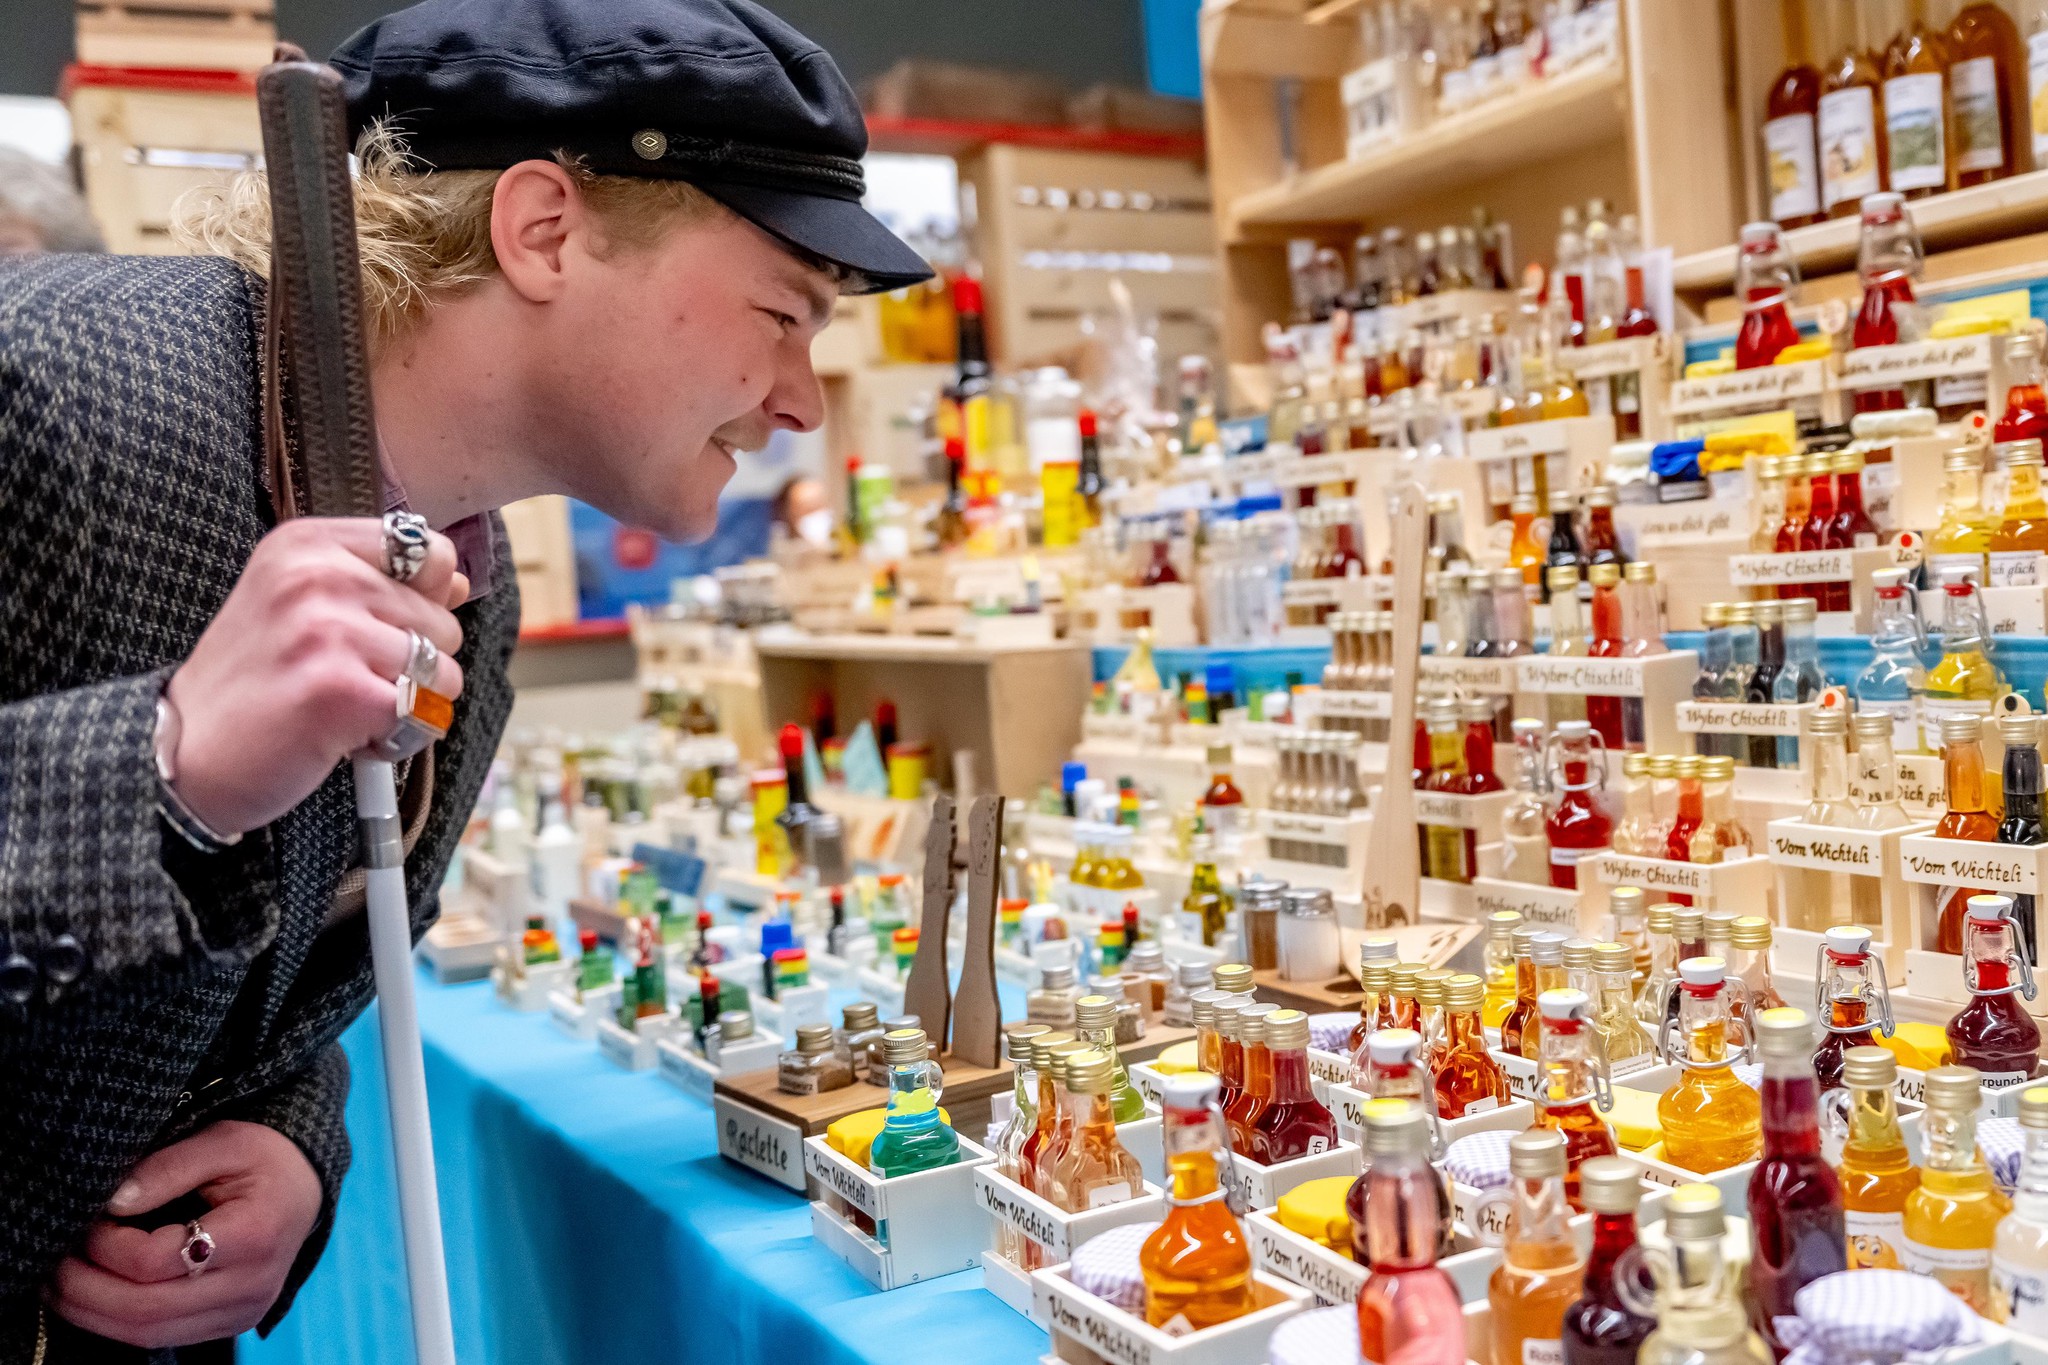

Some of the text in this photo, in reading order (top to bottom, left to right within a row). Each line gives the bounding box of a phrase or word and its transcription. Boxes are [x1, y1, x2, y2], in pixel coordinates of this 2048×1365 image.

[1526, 666, 1635, 689] Wyber-Chischtli
[1686, 709, 1788, 729] Wyber-Chischtli
[1776, 838, 1869, 864] Vom Wichteli
[1603, 861, 1700, 888] Wyber-Chischtli
[1910, 856, 2022, 883] Vom Wichteli
[1309, 1059, 1350, 1084] Wichtel
[725, 1117, 789, 1171] Raclette
[812, 1153, 867, 1208] Vom Wichteli
[984, 1183, 1055, 1247] Vom Wichteli
[1261, 1237, 1293, 1272] Vom
[1048, 1294, 1083, 1334] Vom
